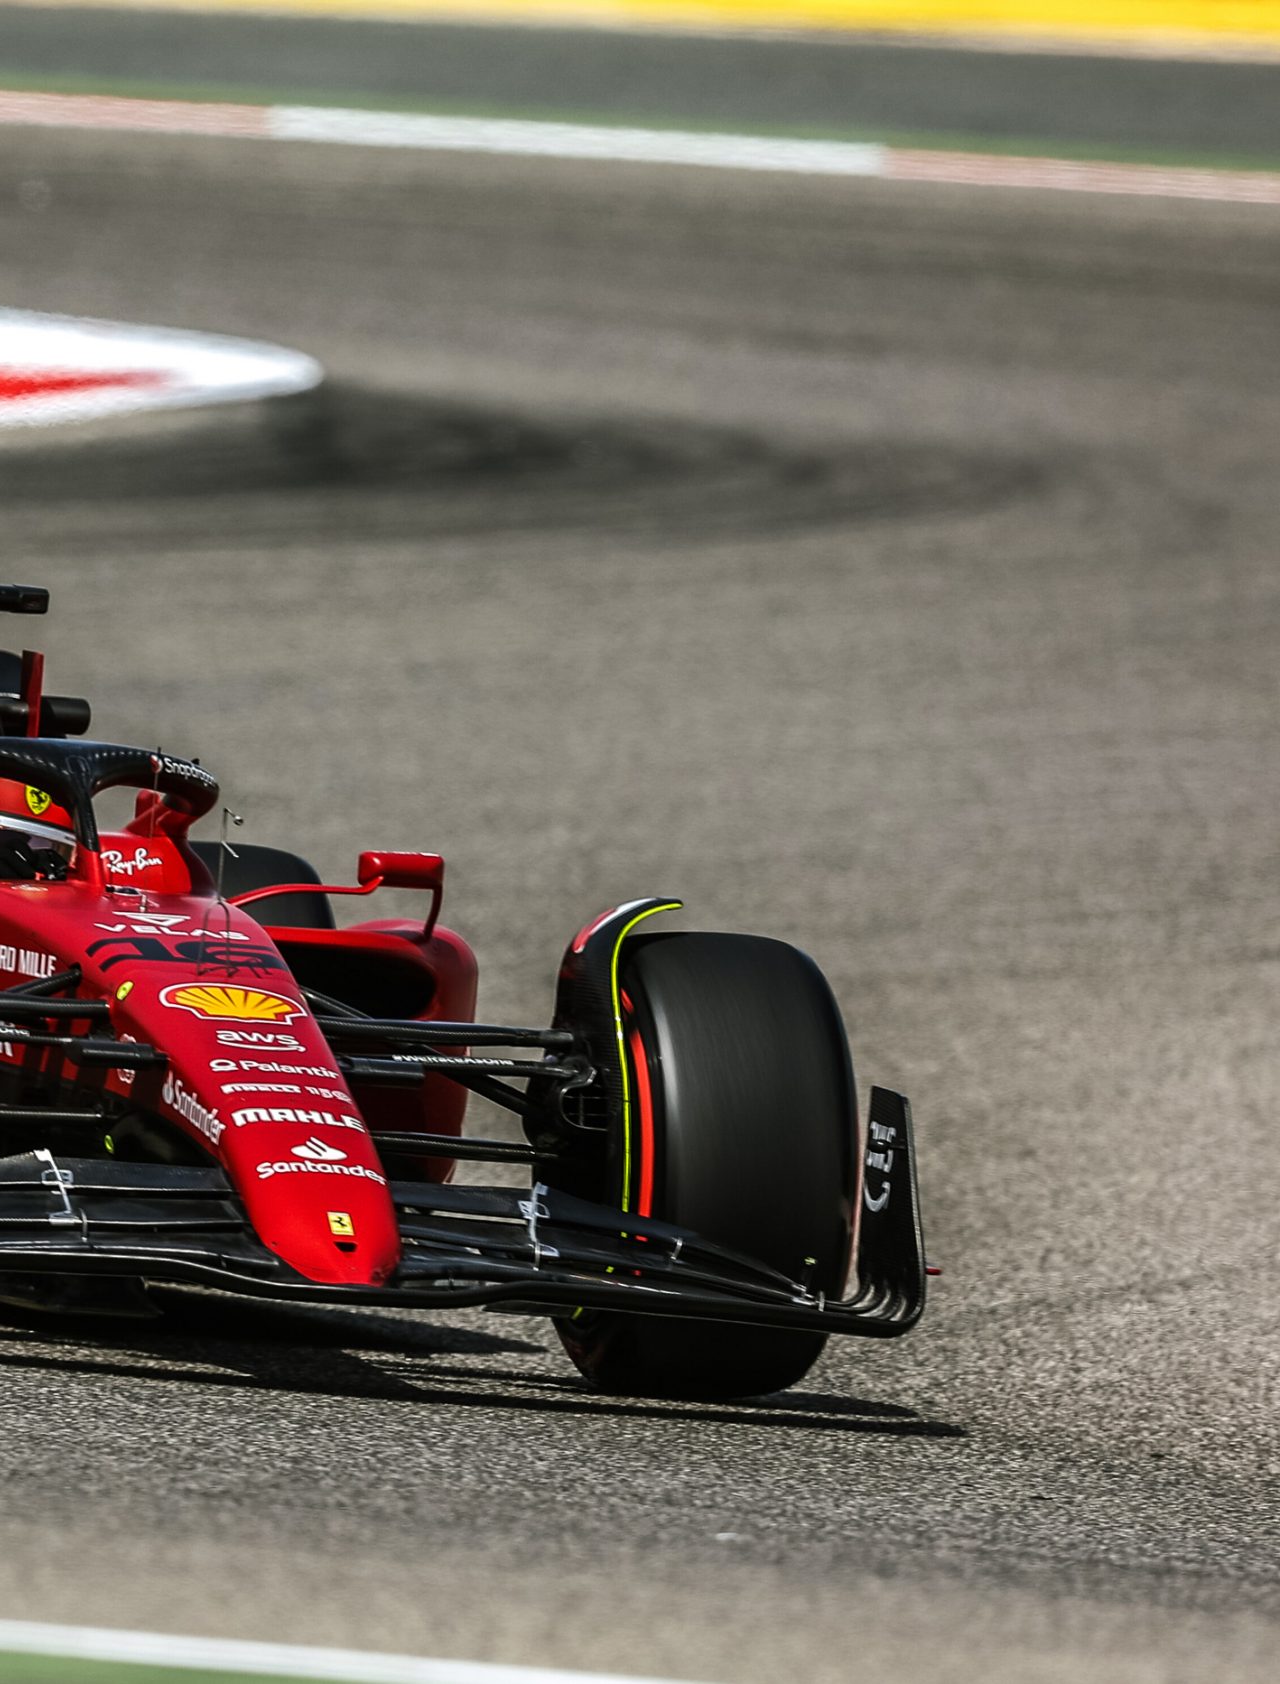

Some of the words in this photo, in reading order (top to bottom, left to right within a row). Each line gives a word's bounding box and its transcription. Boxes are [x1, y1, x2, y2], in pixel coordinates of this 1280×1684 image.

[93, 922, 251, 941] VELAS
[17, 948, 58, 979] MILLE
[216, 1030, 300, 1045] aws
[240, 1060, 340, 1079] Palantir
[173, 1079, 227, 1146] Santander
[231, 1107, 367, 1134] MAHLE
[255, 1159, 387, 1186] Santander
